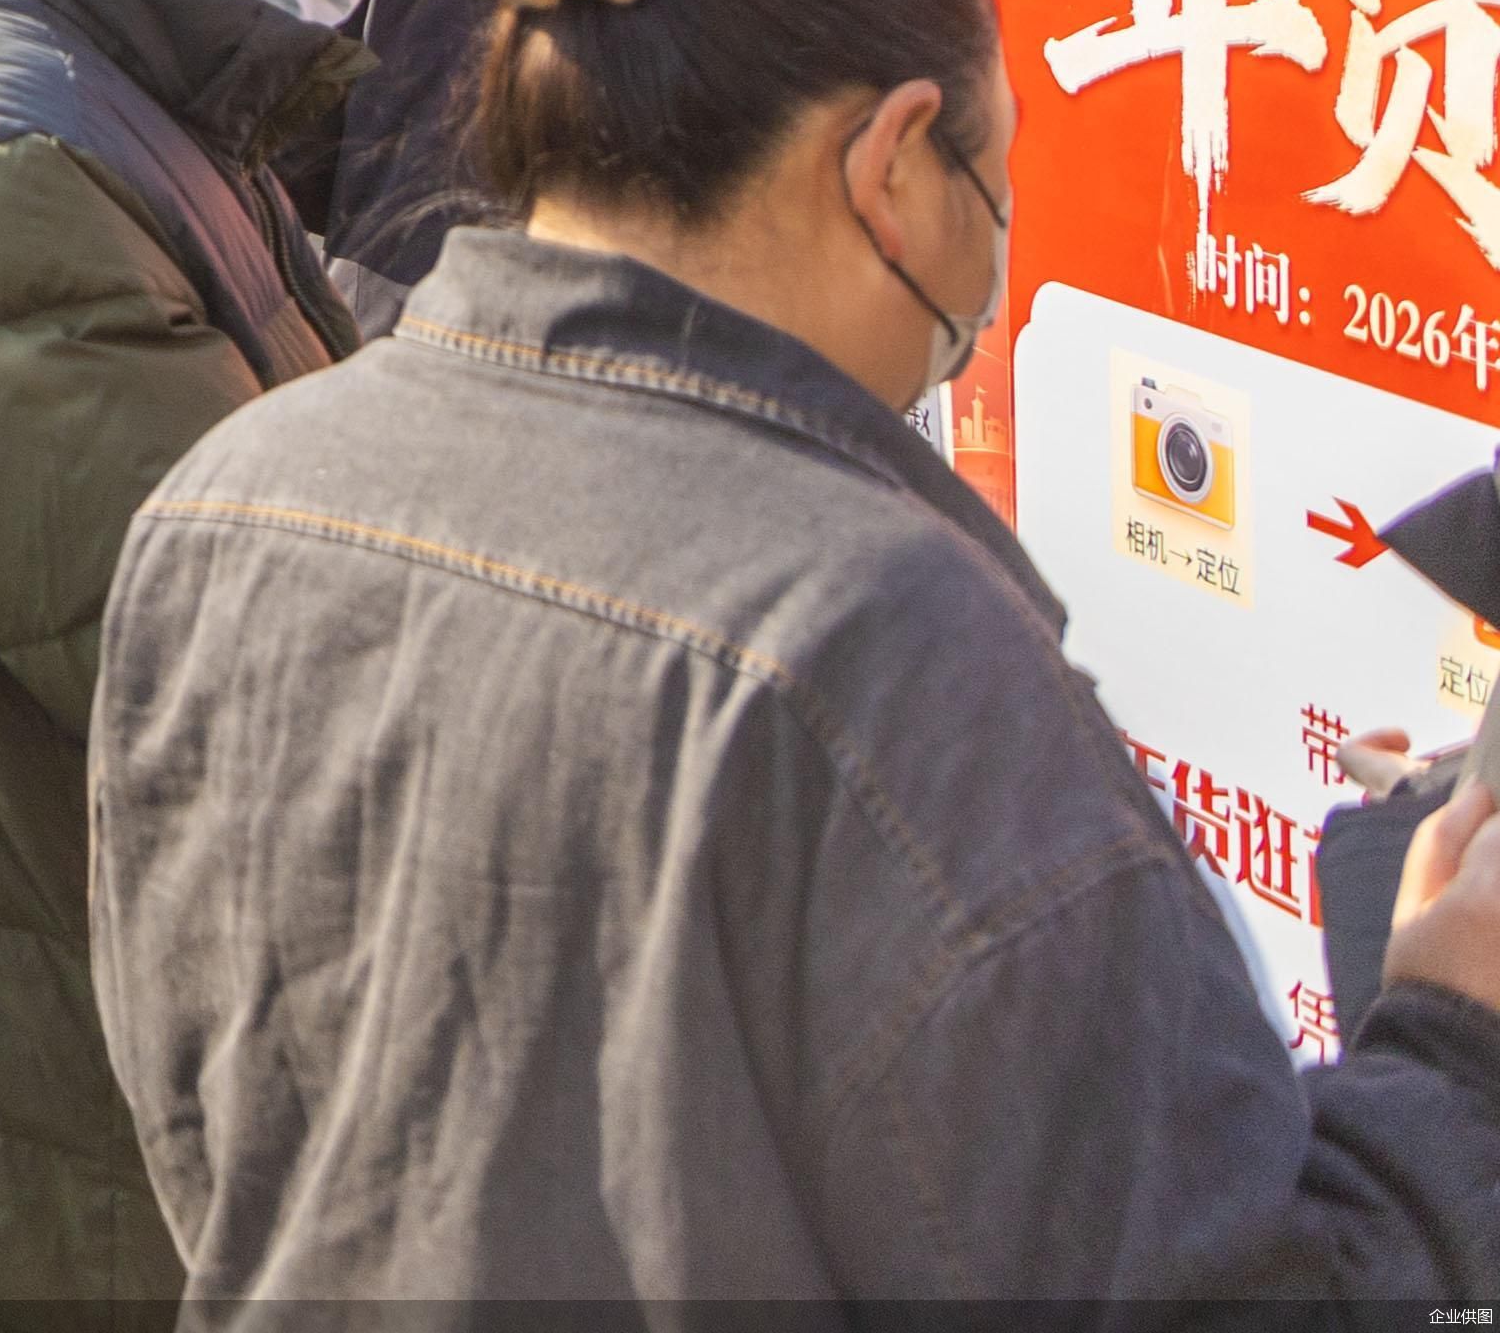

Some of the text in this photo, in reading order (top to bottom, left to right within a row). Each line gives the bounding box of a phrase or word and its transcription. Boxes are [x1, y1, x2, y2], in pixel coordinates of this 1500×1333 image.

[1126, 515, 1241, 597] 相机 定位
[1118, 729, 1323, 929] 货逛
